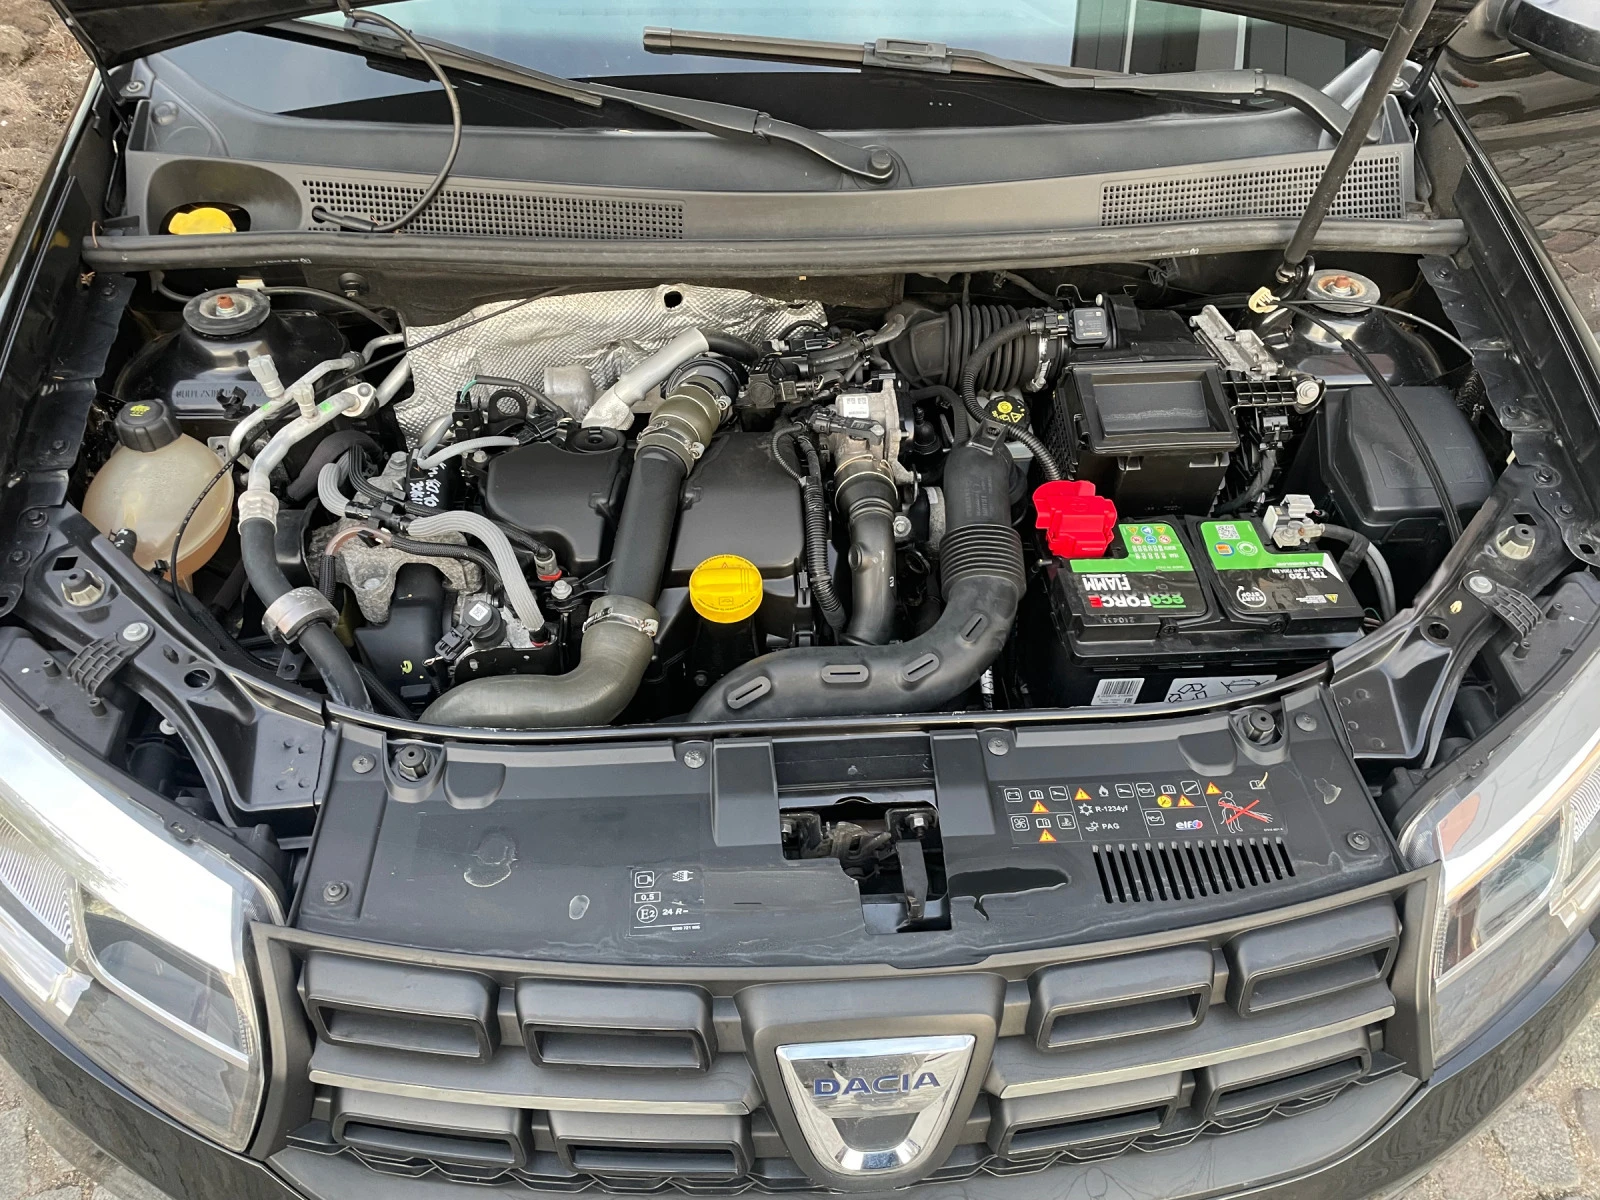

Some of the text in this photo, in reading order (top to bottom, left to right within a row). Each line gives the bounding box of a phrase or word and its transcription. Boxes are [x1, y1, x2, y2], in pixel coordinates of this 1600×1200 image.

[1289, 572, 1310, 580] 720
[1082, 576, 1131, 591] FIAMM
[1095, 804, 1128, 813] R-1234yf
[1101, 822, 1120, 830] PAG
[1175, 821, 1195, 830] elf
[640, 908, 656, 920] E2
[662, 908, 673, 916] 24
[814, 1071, 941, 1096] DACIA
